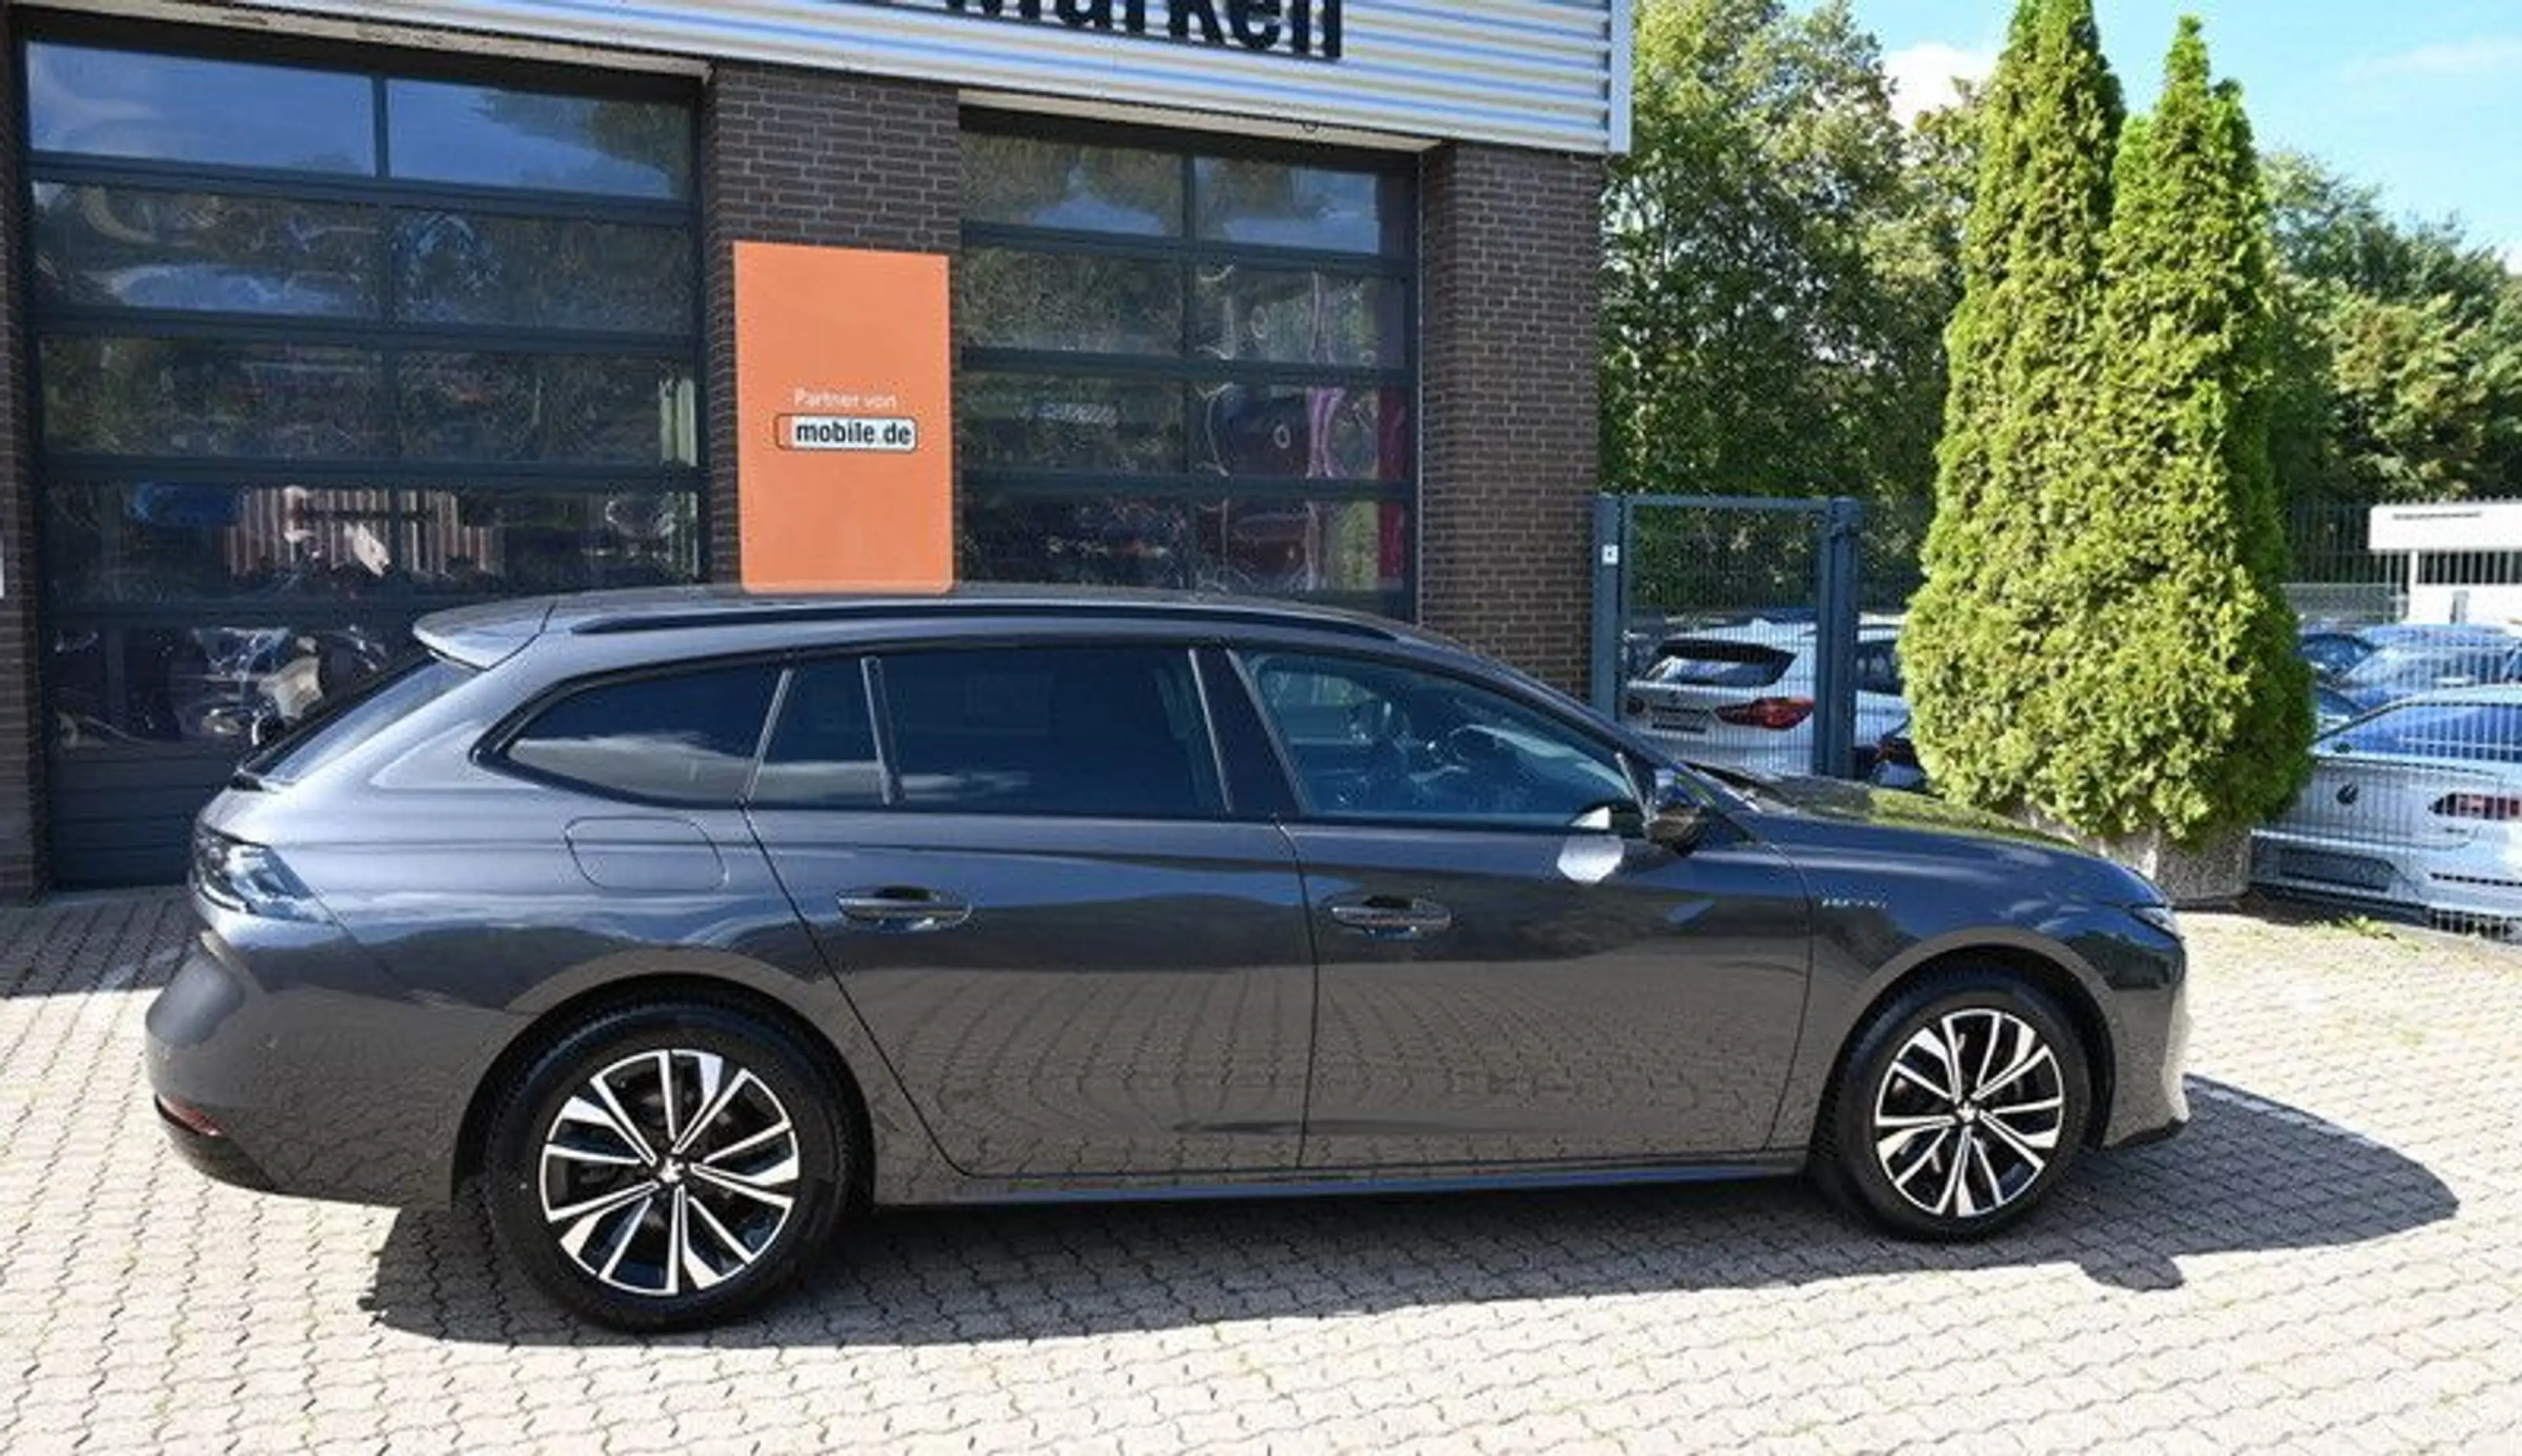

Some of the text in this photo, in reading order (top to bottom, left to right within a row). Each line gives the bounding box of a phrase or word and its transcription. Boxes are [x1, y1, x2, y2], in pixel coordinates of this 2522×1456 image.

[794, 388, 897, 409] Partner von
[796, 420, 912, 445] mobile.de
